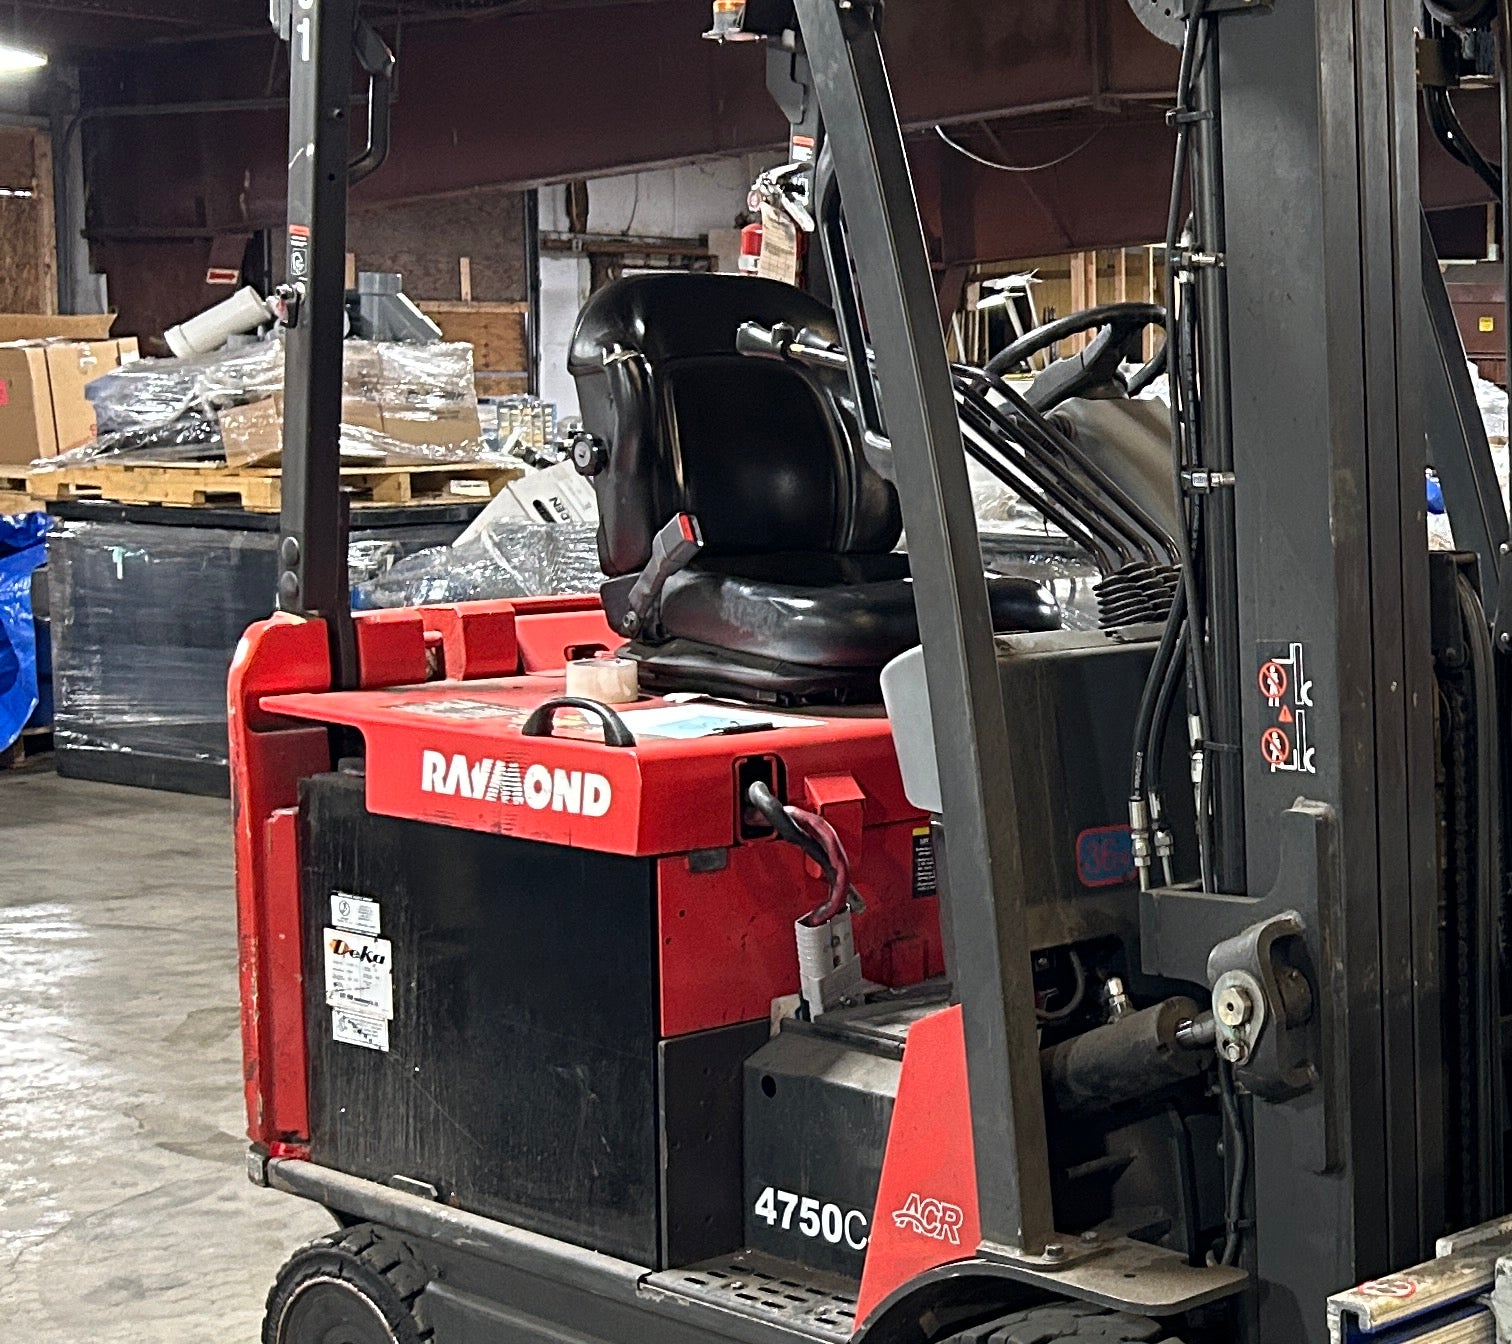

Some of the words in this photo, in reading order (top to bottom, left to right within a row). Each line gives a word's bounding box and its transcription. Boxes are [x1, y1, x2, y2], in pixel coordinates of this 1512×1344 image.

[420, 749, 612, 818] RAYMOND
[754, 1186, 871, 1250] 4750C
[891, 1192, 963, 1245] ACR
